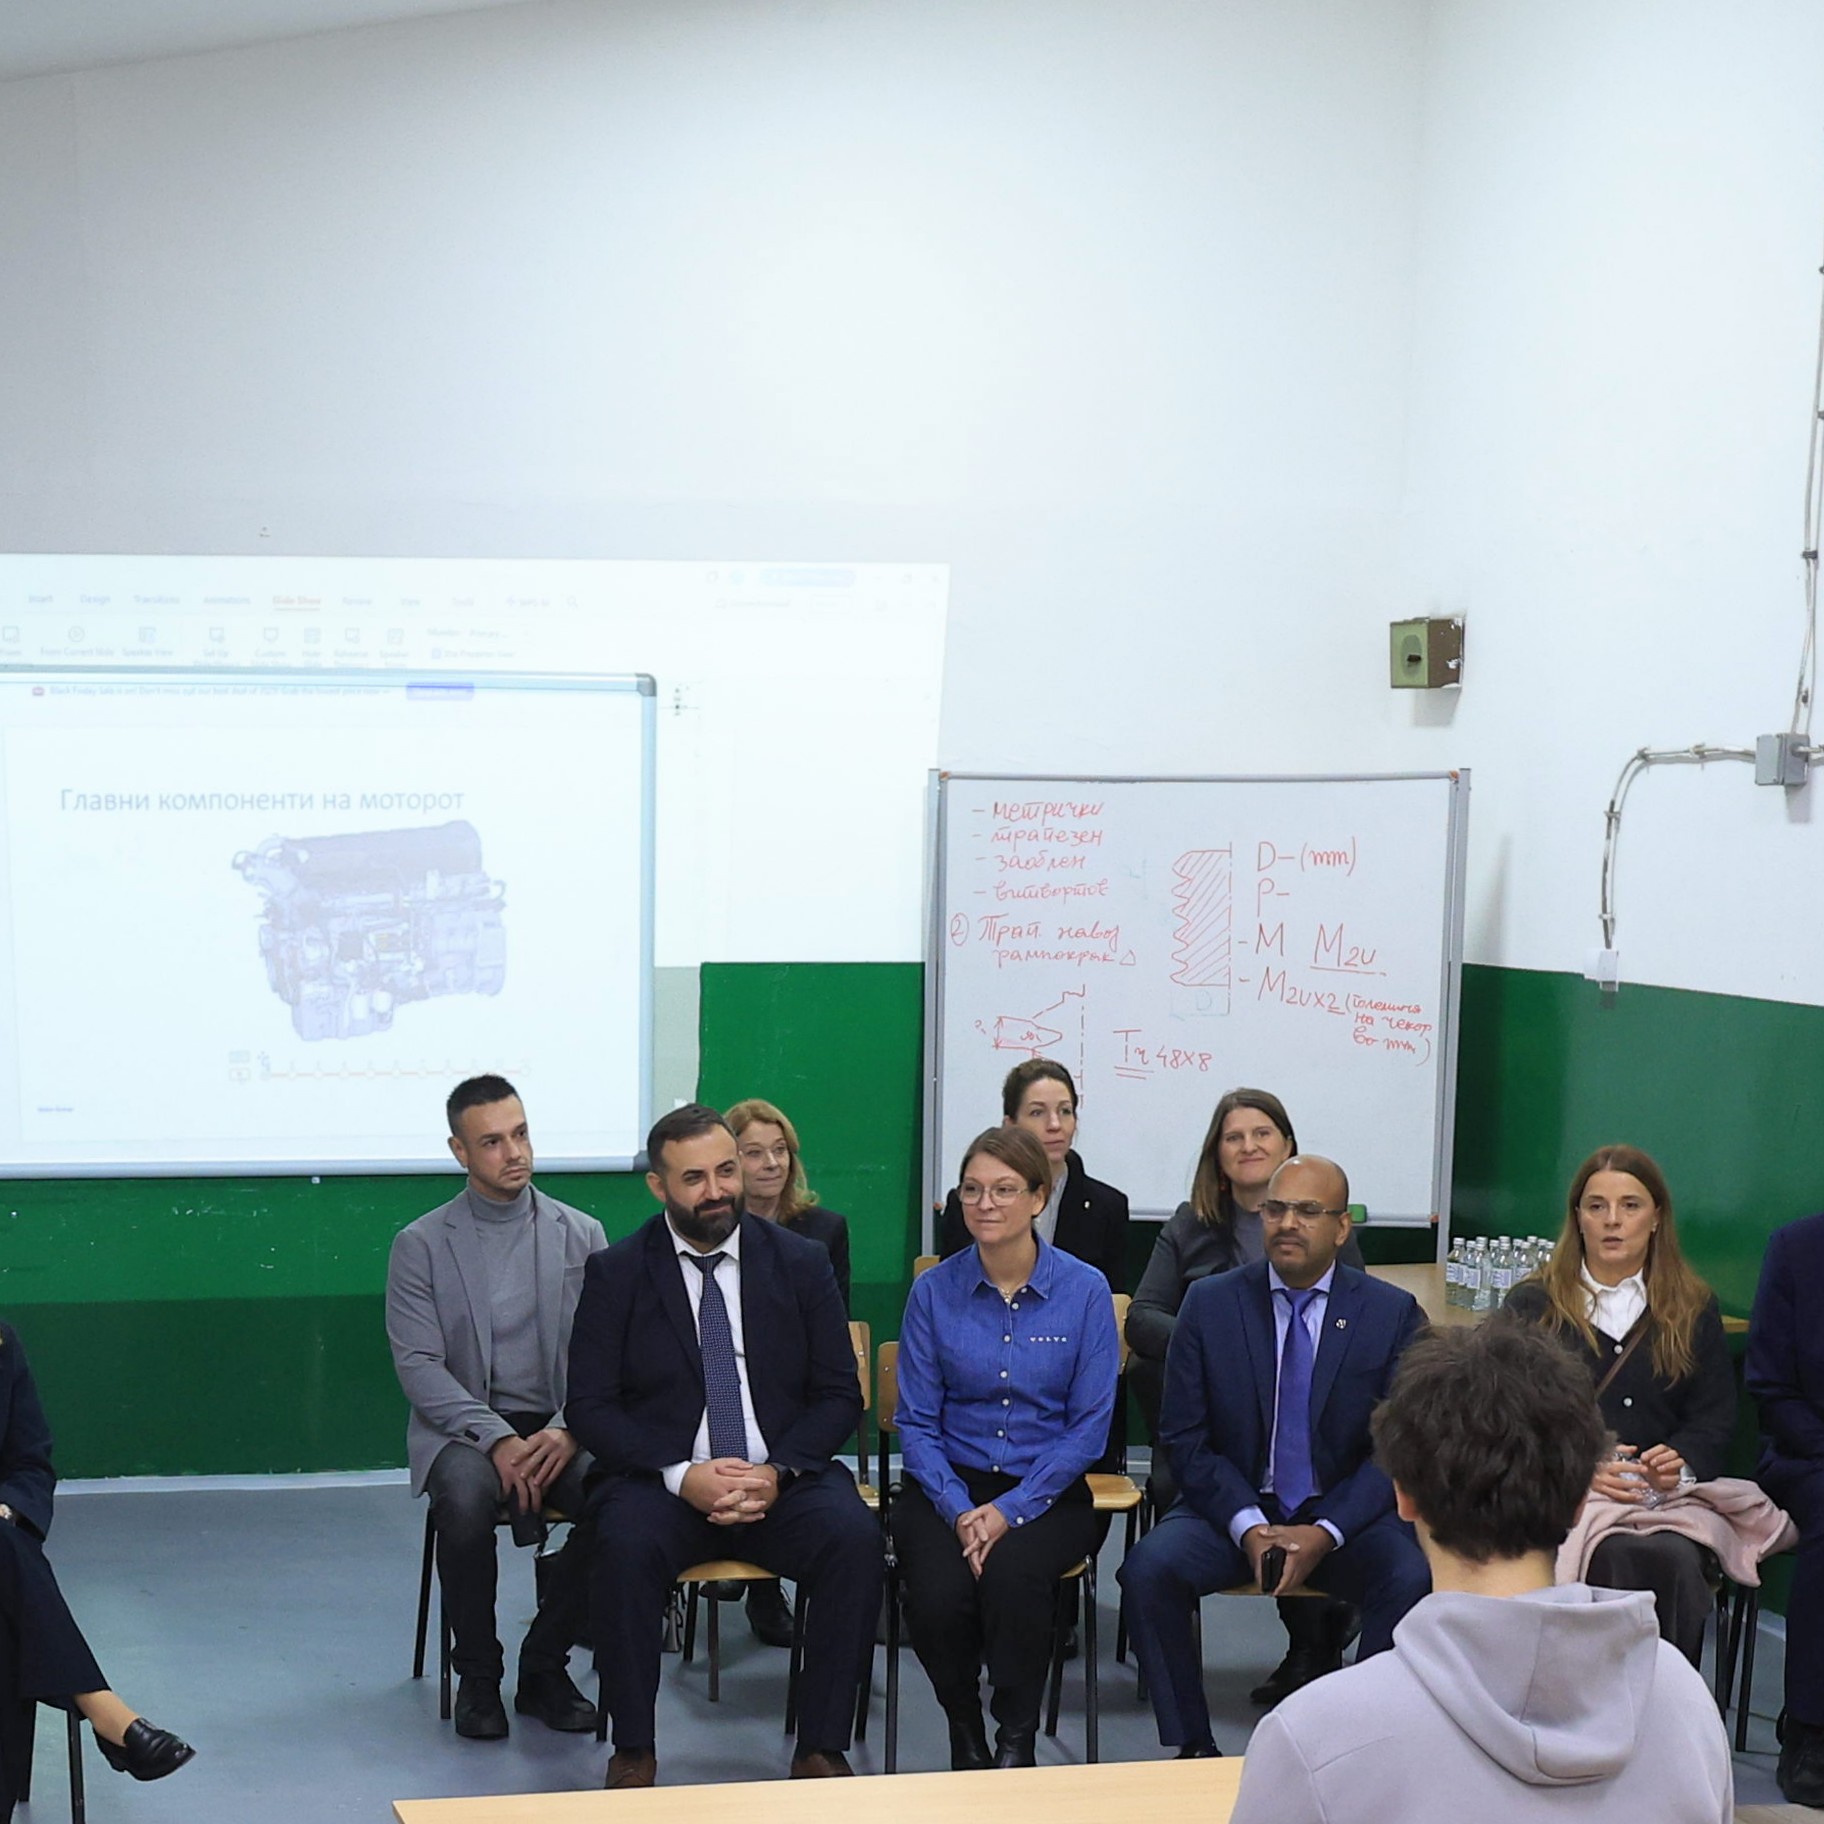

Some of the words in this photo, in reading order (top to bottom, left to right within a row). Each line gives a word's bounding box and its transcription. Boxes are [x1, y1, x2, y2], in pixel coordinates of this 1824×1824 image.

[60, 789, 150, 813] Главни
[157, 789, 314, 812] компоненти
[322, 790, 353, 811] на
[359, 790, 465, 815] моторот
